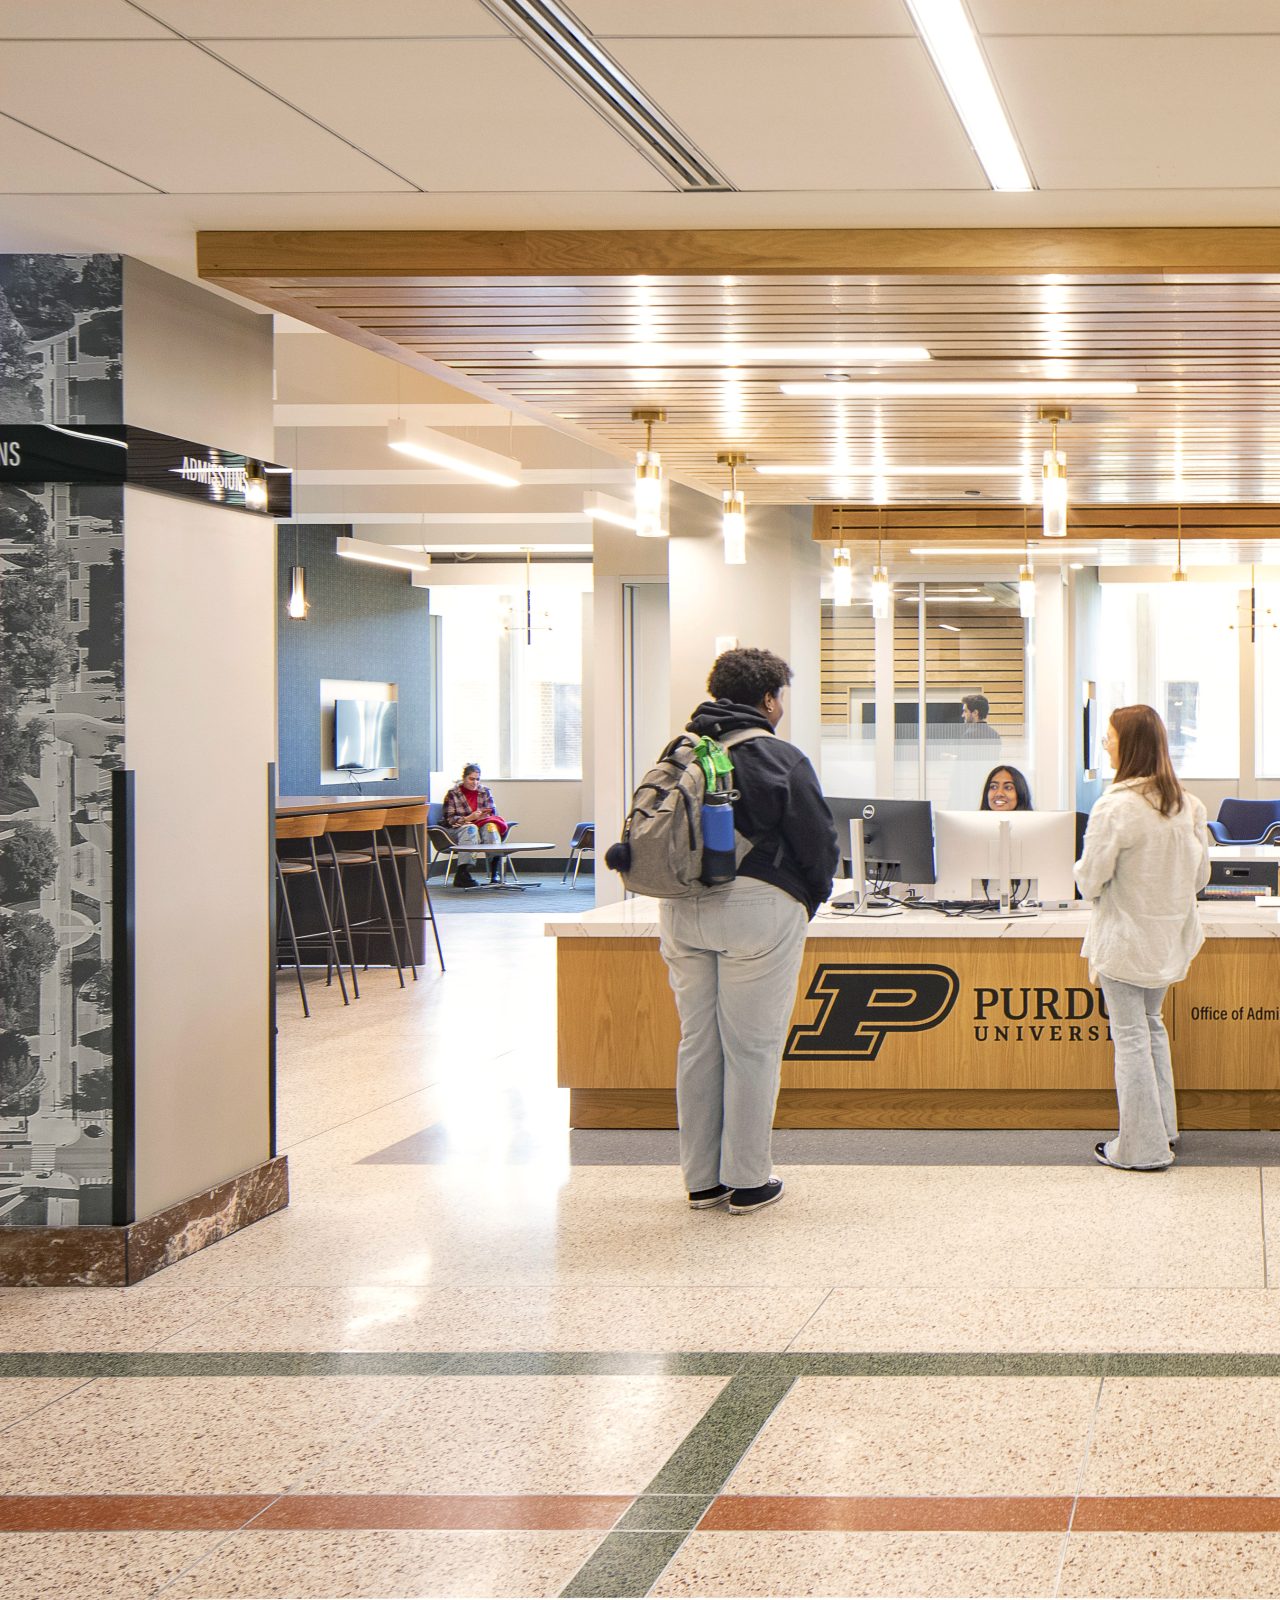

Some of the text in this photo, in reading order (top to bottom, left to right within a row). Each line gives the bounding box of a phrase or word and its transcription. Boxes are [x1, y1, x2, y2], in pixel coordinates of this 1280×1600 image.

[181, 456, 249, 492] ADMISSIONS
[1191, 1006, 1228, 1021] Office
[1231, 1006, 1244, 1021] of
